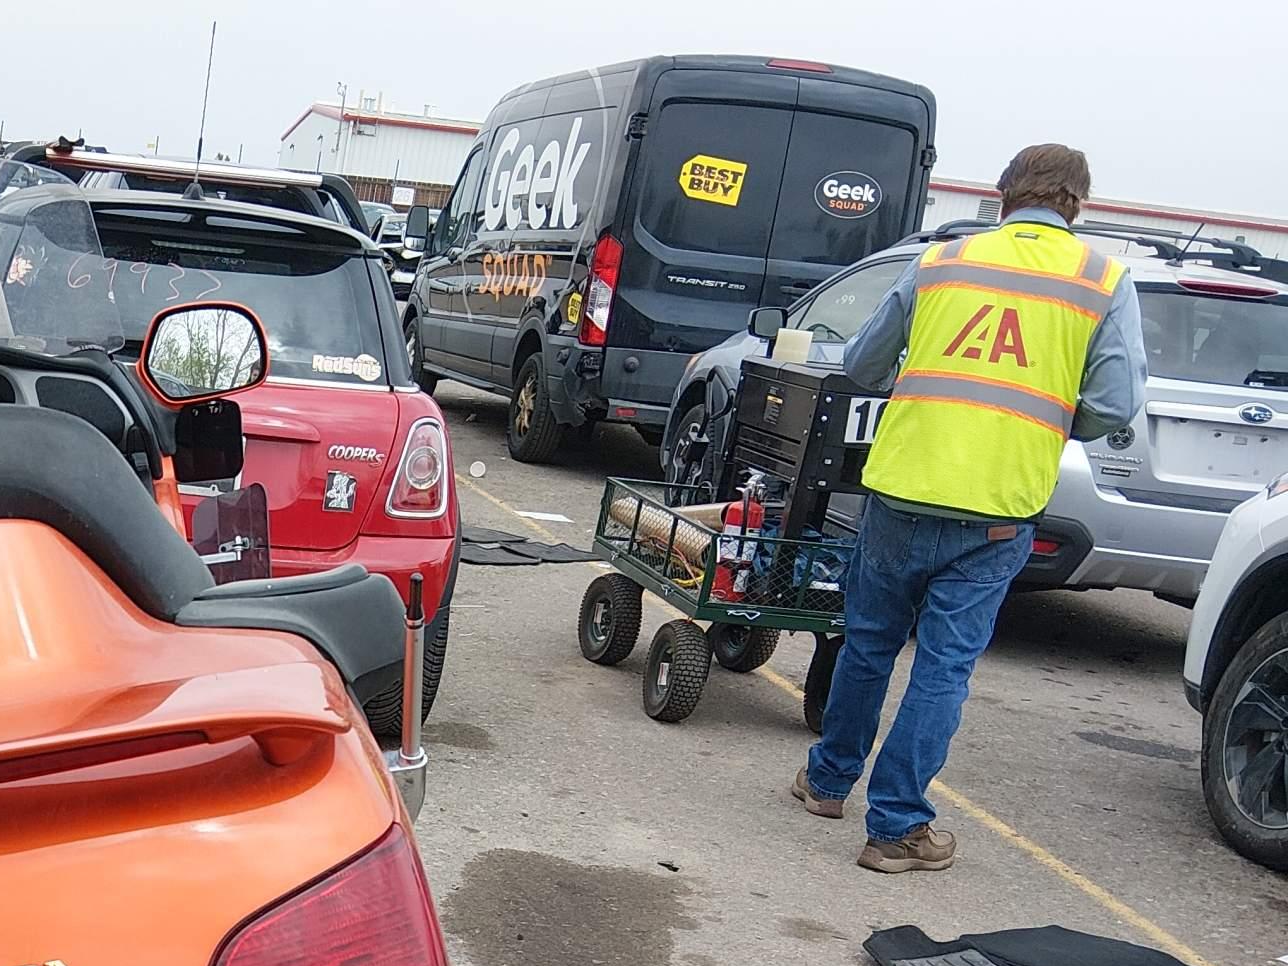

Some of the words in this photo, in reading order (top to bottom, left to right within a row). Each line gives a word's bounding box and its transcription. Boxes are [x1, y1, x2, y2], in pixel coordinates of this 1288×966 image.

[485, 117, 592, 231] Geek
[689, 162, 743, 184] BEST
[688, 177, 736, 198] BUY
[823, 179, 876, 203] Geek
[828, 199, 865, 211] SQUAD
[478, 253, 547, 303] SQUAD
[667, 275, 728, 288] TRANSIT
